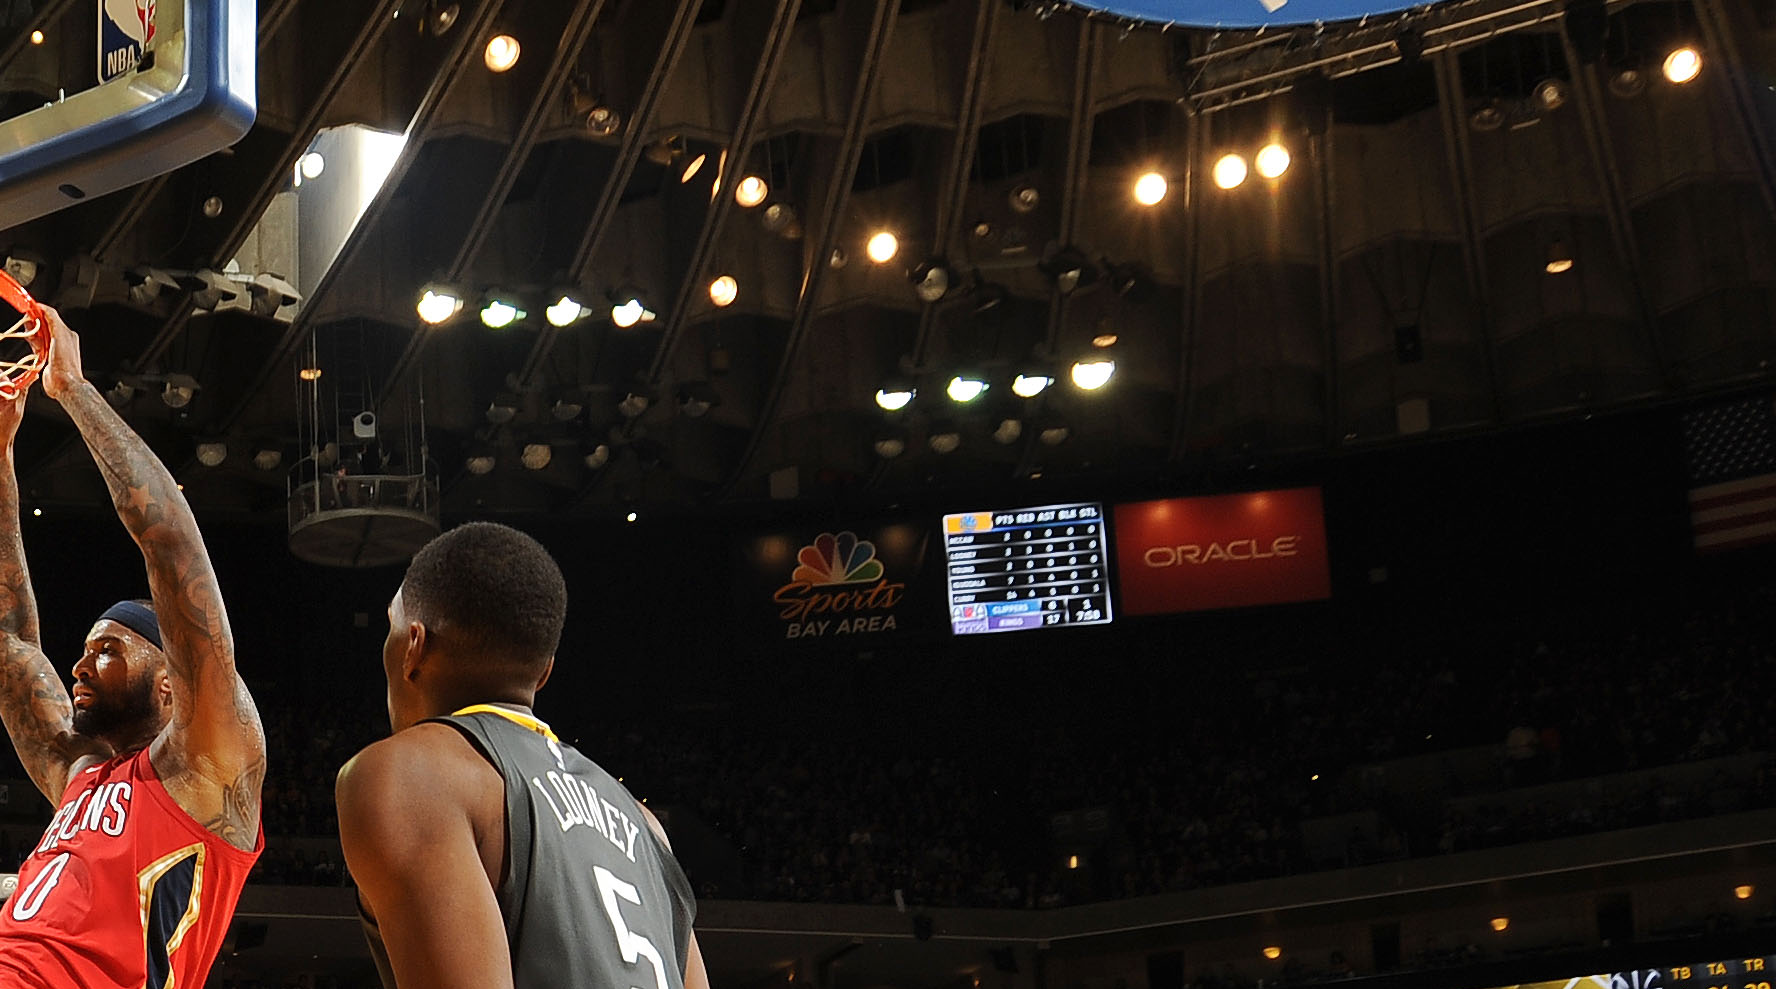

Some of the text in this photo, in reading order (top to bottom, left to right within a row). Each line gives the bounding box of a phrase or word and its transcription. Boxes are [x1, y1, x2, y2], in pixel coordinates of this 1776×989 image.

[107, 45, 136, 76] NBA
[1144, 536, 1297, 568] ORACLE
[773, 579, 904, 623] Sports
[786, 615, 898, 639] BAY AREA
[532, 769, 640, 863] LOONEY
[13, 852, 70, 921] 0
[1671, 958, 1765, 980] TB TA TR
